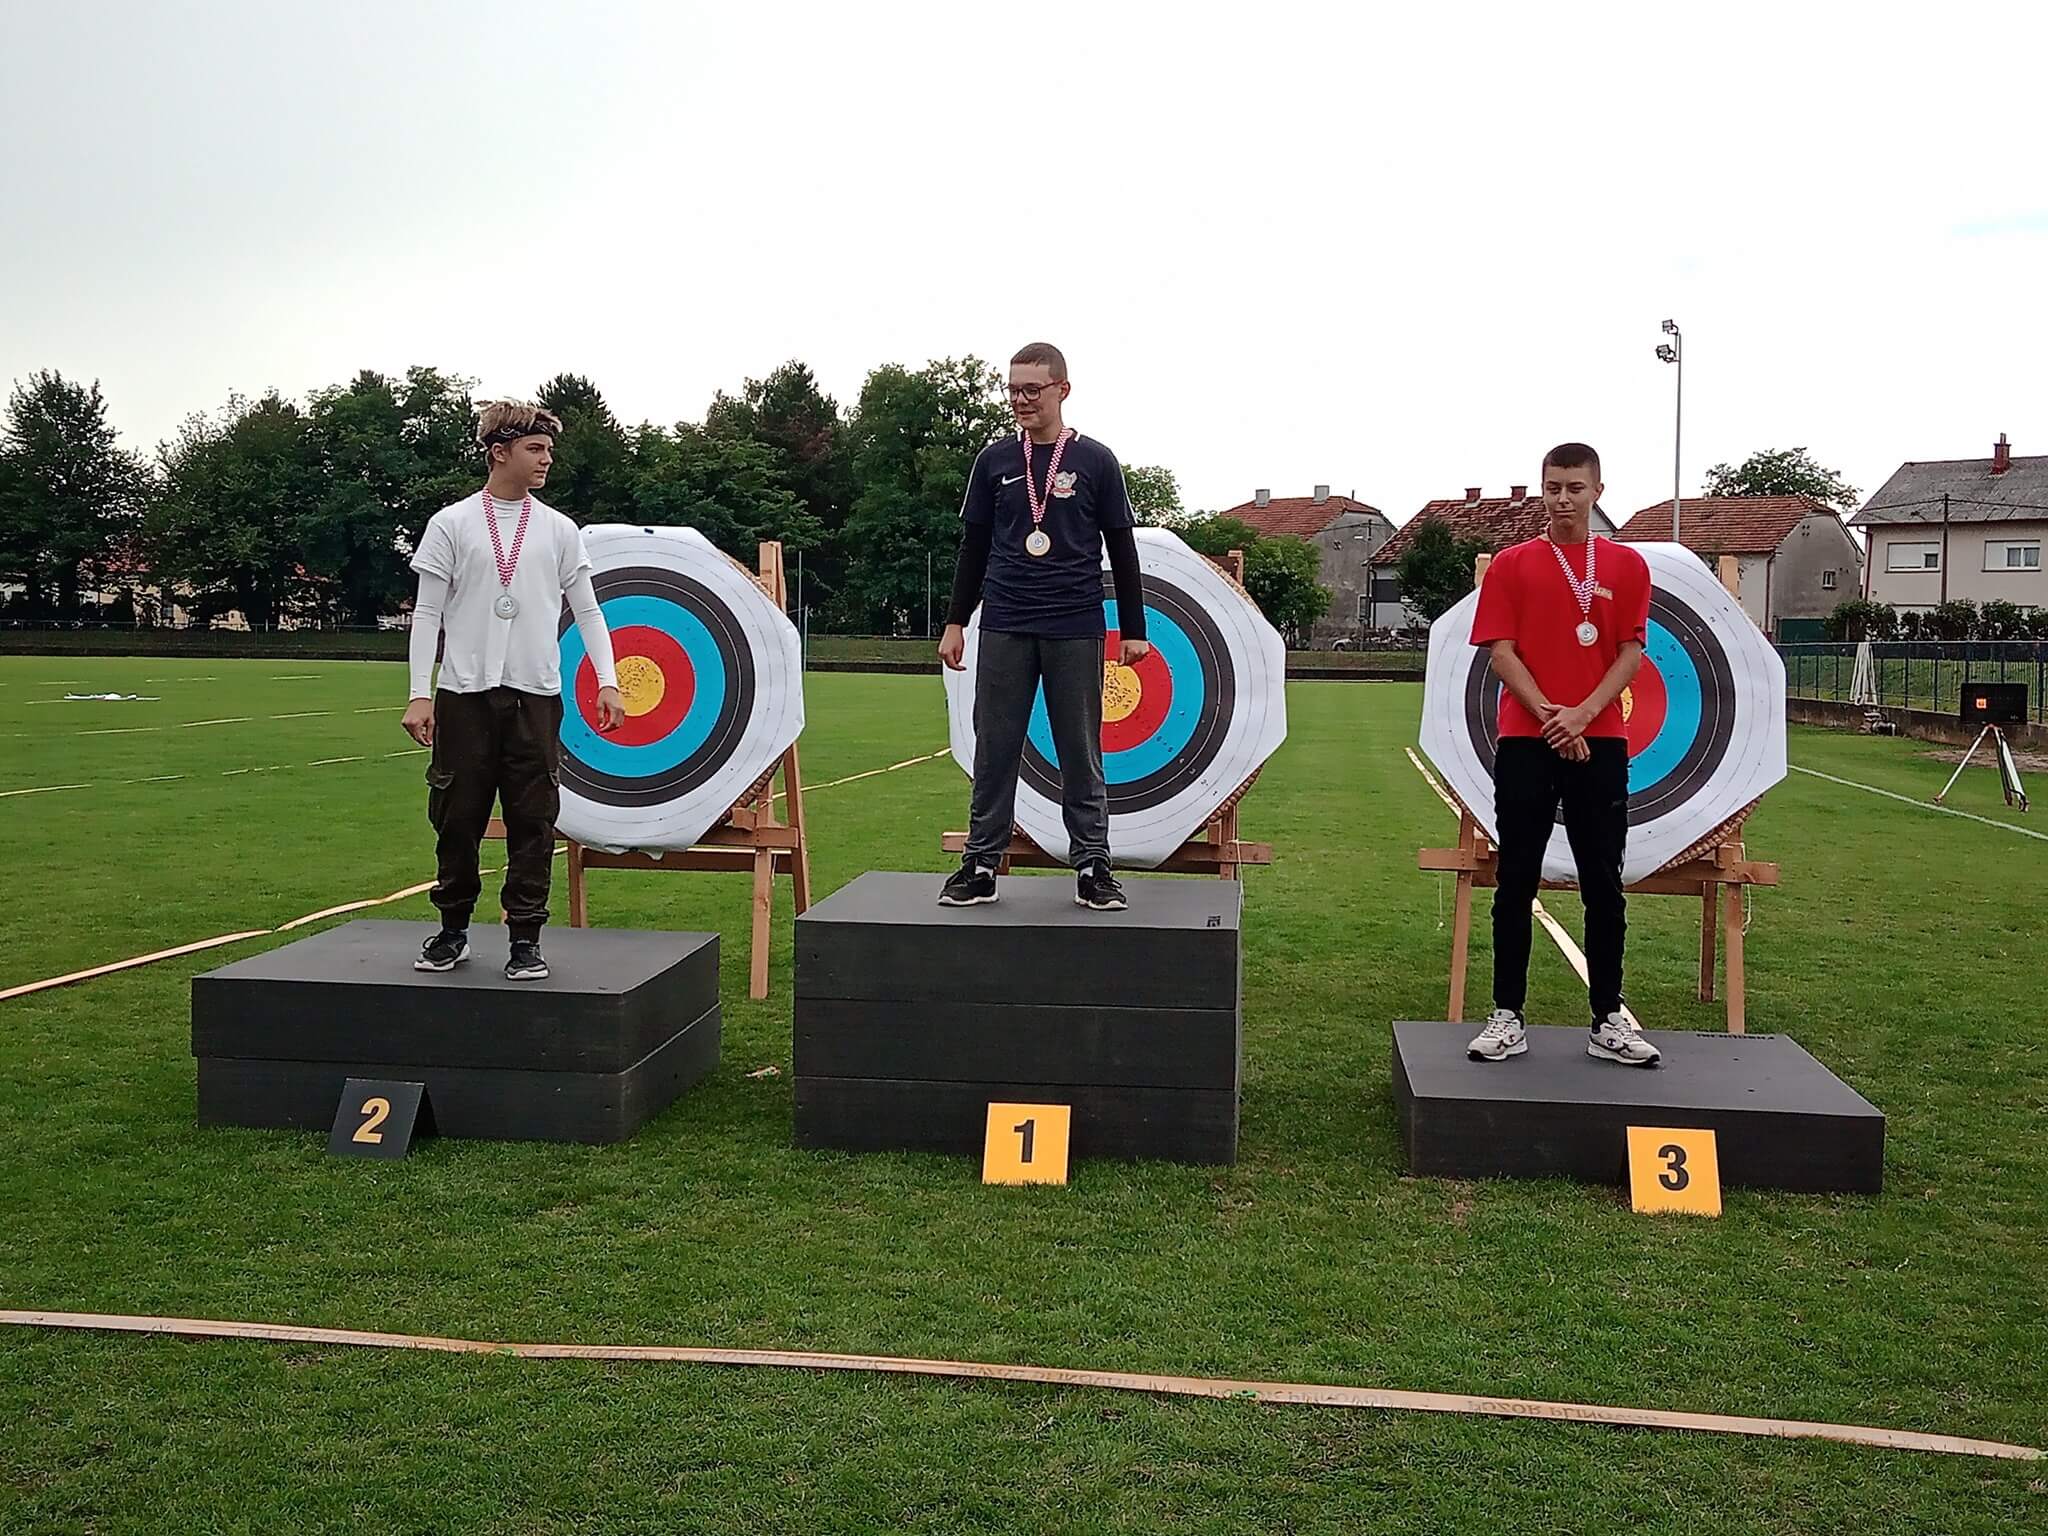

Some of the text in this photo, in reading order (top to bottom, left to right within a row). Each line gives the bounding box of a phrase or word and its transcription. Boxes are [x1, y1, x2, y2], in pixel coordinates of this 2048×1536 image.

[351, 1096, 392, 1145] 2
[1013, 1119, 1036, 1163] 1
[1658, 1144, 1690, 1191] 3
